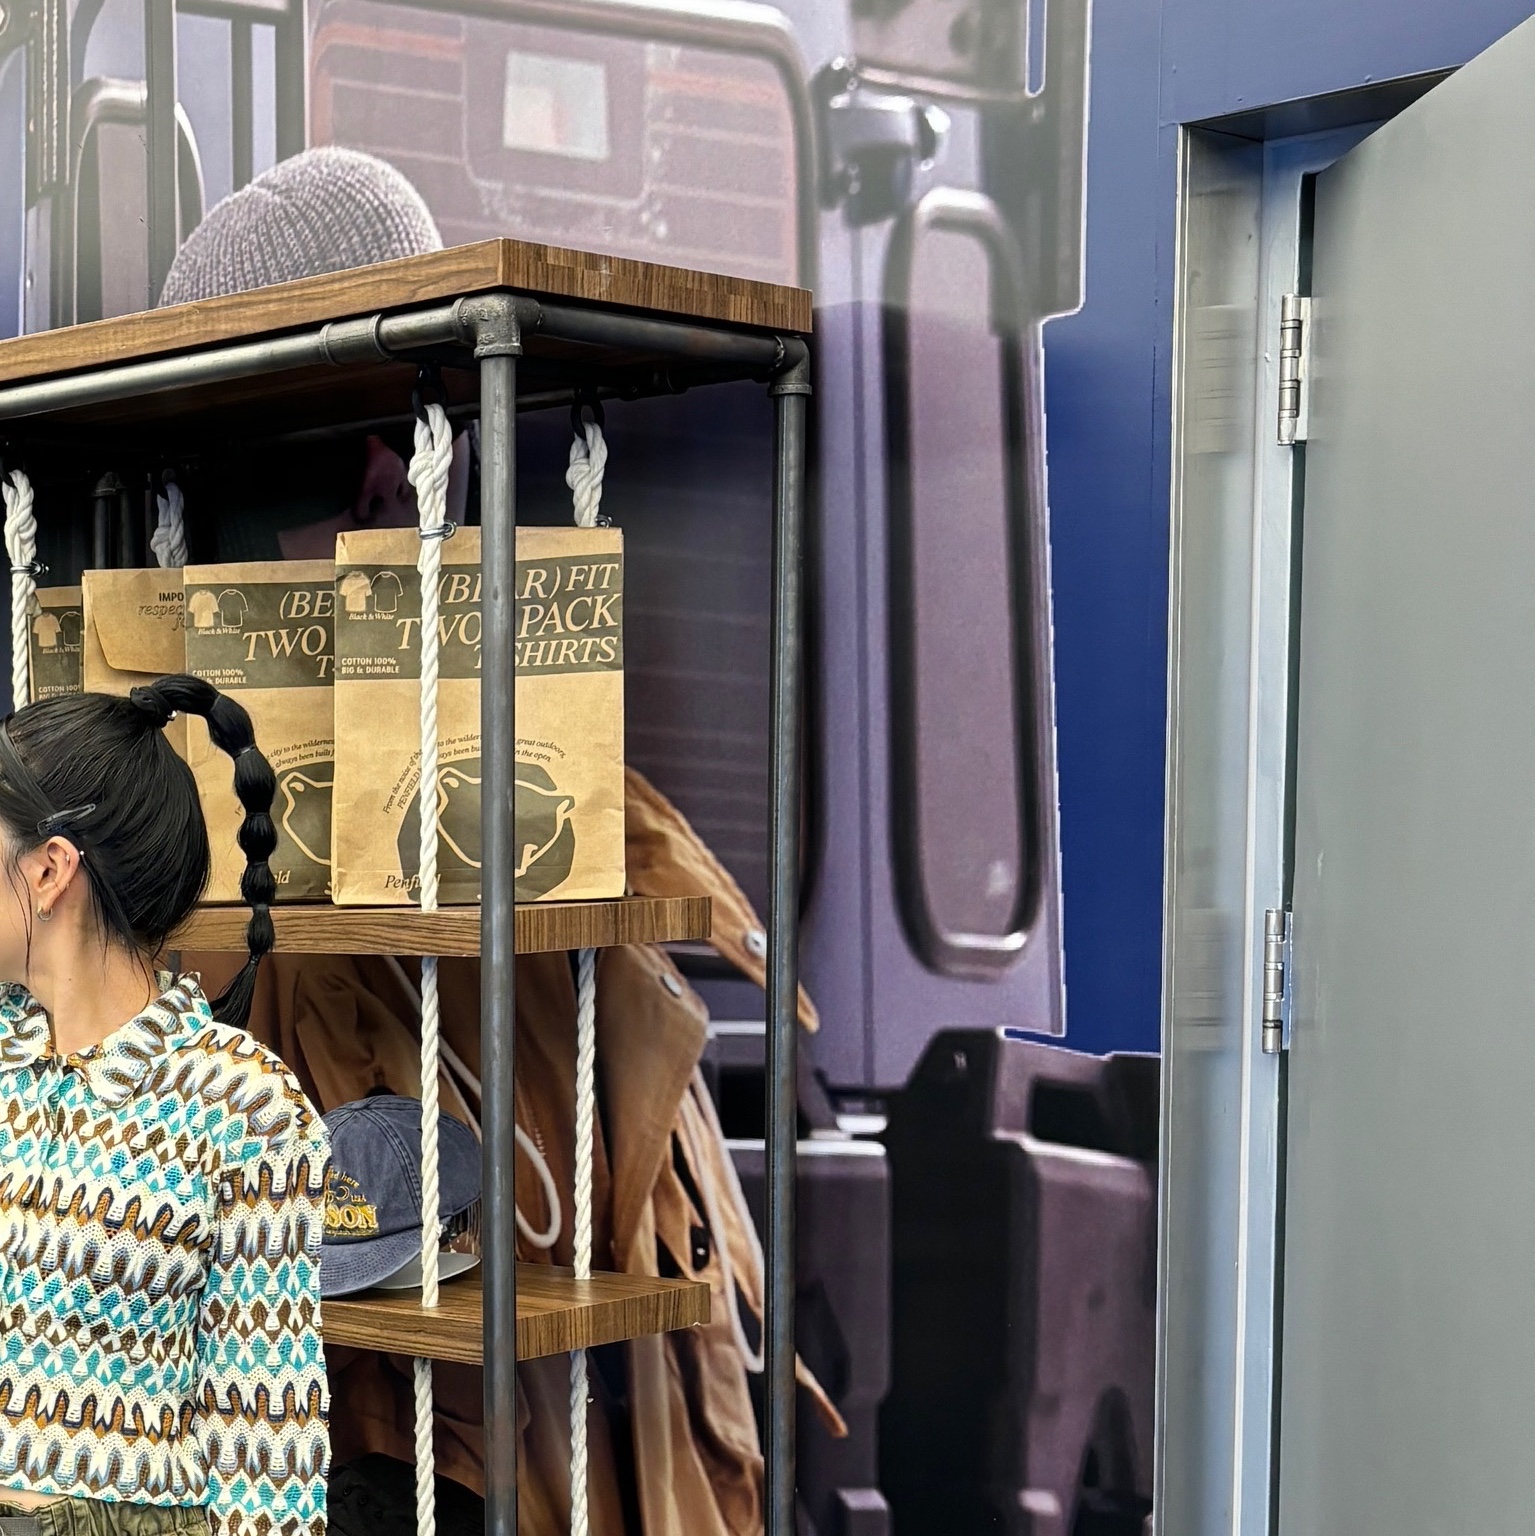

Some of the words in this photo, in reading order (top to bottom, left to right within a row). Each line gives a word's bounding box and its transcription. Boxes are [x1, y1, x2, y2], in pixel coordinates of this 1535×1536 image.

[565, 563, 620, 592] FIT
[138, 604, 185, 620] respec
[516, 593, 622, 639] PACK
[242, 624, 328, 662] TWO
[341, 657, 373, 666] COTTON
[374, 656, 397, 666] 100%
[341, 666, 356, 675] BIG
[365, 665, 400, 674] DURABLE
[457, 734, 481, 743] wilder
